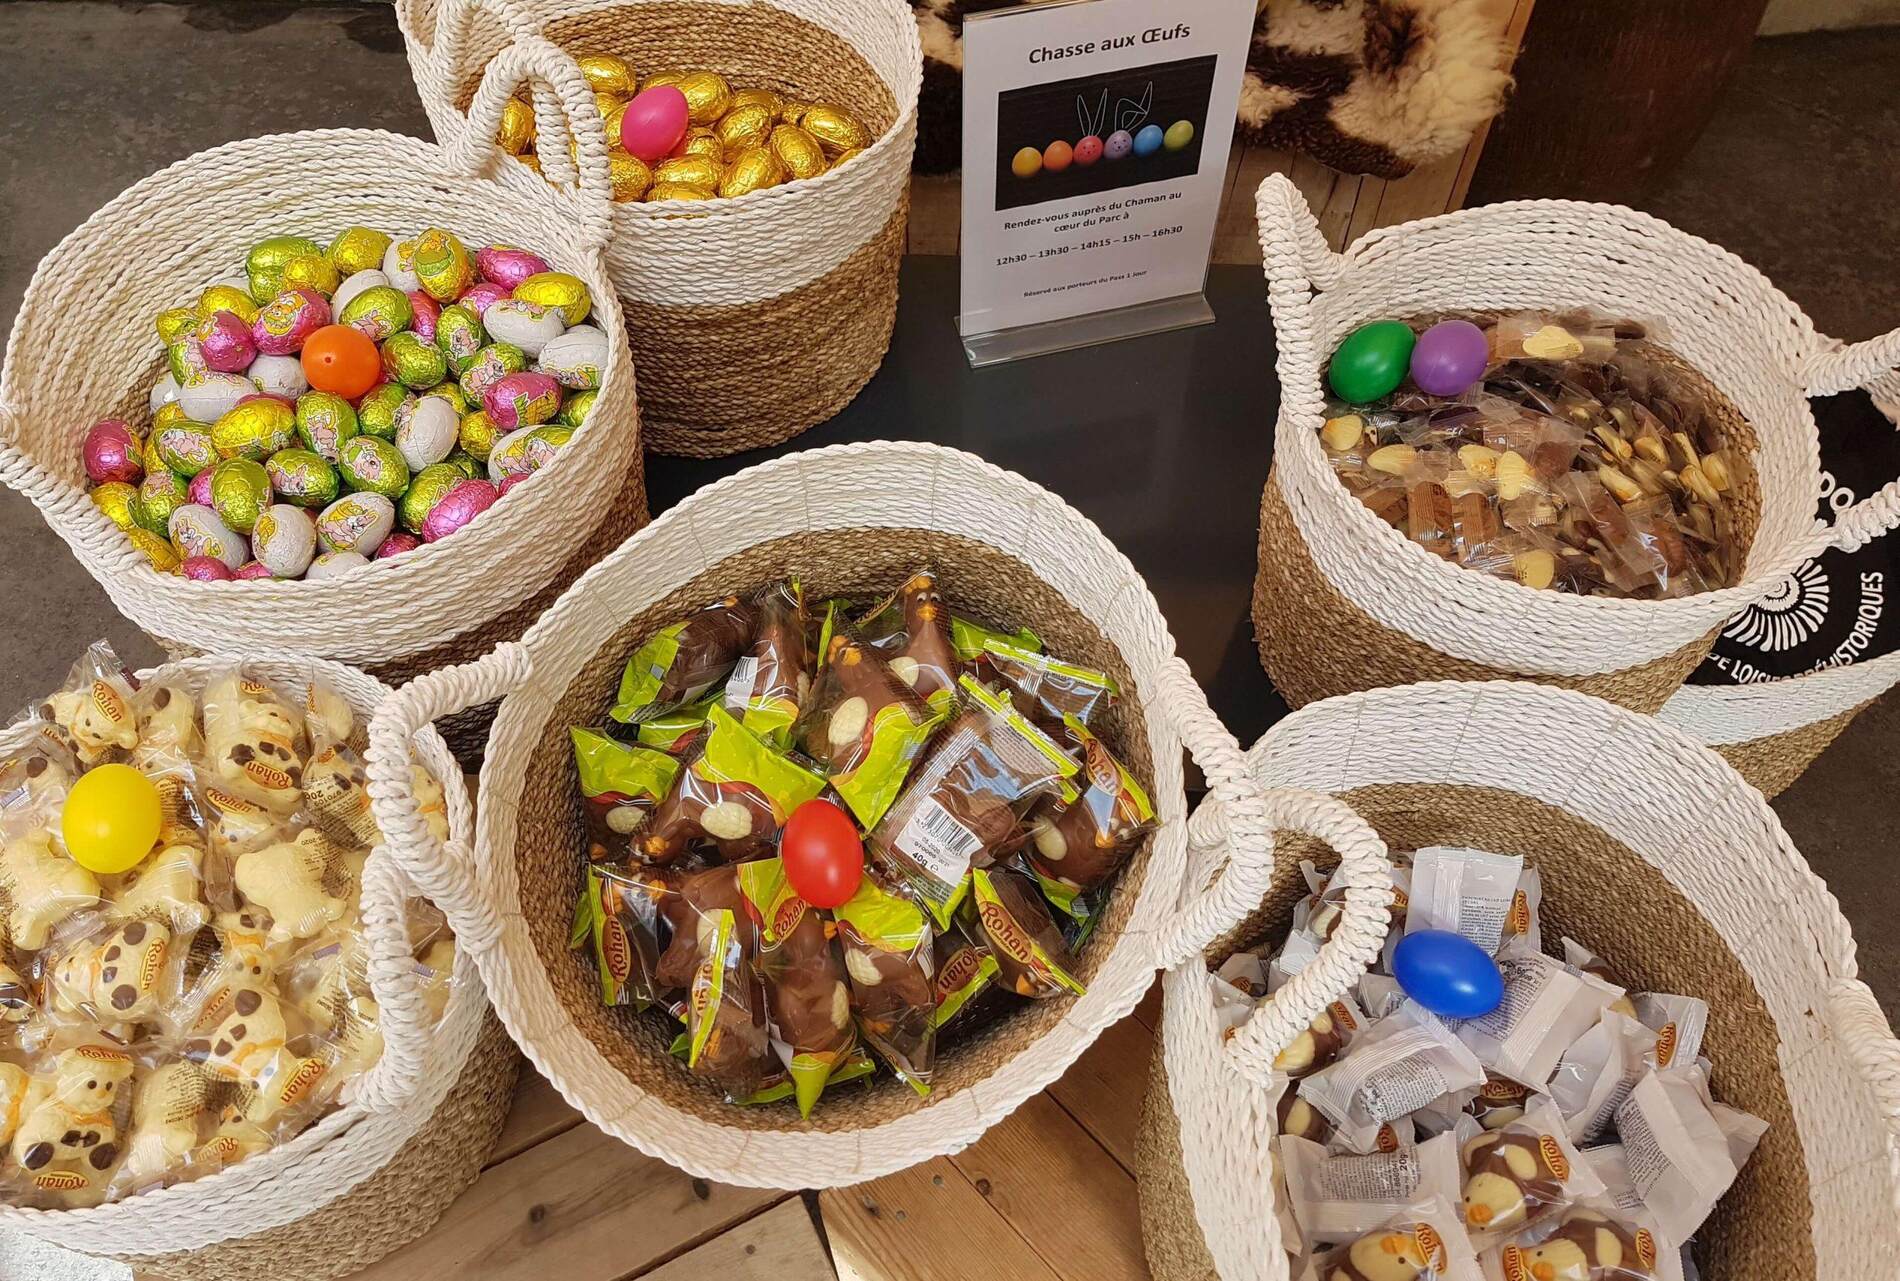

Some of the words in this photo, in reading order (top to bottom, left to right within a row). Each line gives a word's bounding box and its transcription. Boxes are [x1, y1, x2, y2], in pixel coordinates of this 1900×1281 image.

[1028, 40, 1096, 64] Chasse
[1101, 33, 1136, 51] aux
[1141, 23, 1191, 44] Œufs
[1004, 212, 1070, 230] Rendez-vous
[1071, 205, 1107, 219] auprès
[1109, 202, 1122, 211] du
[1125, 193, 1167, 208] Chaman
[1168, 191, 1182, 200] au
[1054, 222, 1081, 233] cœur
[1083, 217, 1096, 228] du
[1099, 212, 1121, 224] Parc
[1123, 211, 1130, 220] à
[996, 253, 1028, 266] 12h30
[1038, 246, 1069, 258] 13h30
[1080, 238, 1112, 251] 14h15
[1122, 233, 1141, 243] 15h
[1152, 225, 1184, 238] 16h30
[1053, 284, 1066, 293] aux
[1067, 280, 1097, 290] porteurs
[1099, 276, 1108, 284] du
[93, 681, 123, 722] Rohan
[247, 761, 293, 787] Rohan
[611, 920, 628, 979] Rohan
[981, 903, 1030, 961] Rohan
[142, 942, 165, 990] Rohan
[281, 1059, 325, 1103] Rohan
[1400, 1154, 1409, 1171] 20g
[1543, 1135, 1565, 1179] Rohan
